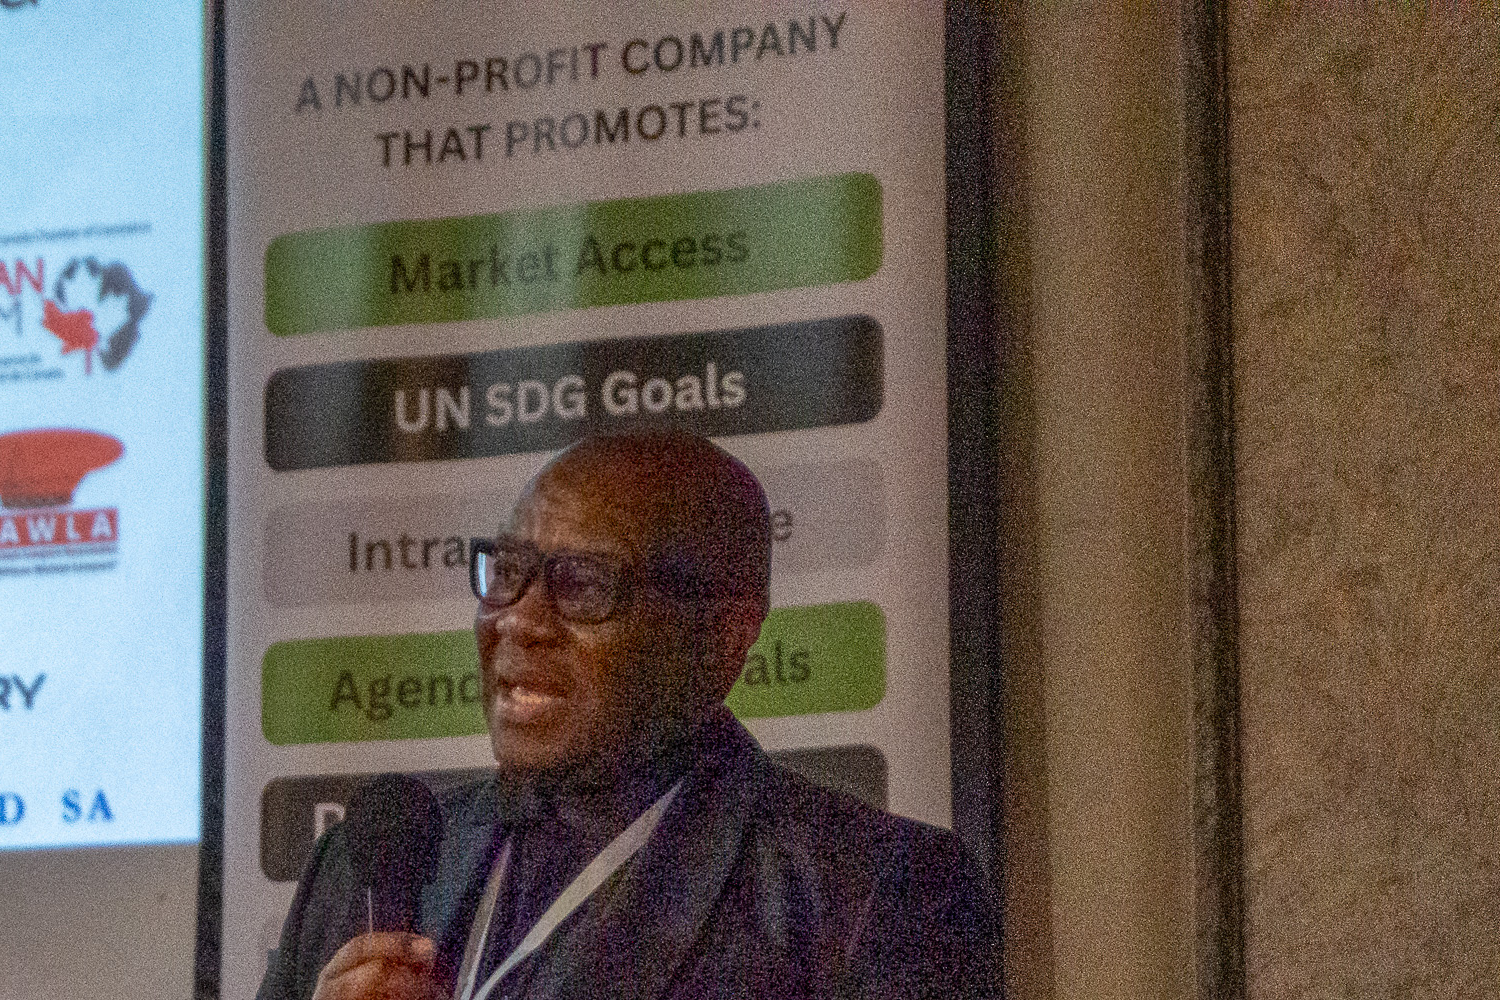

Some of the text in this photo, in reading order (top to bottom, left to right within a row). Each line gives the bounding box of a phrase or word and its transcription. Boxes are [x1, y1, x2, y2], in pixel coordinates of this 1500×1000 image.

[295, 12, 846, 113] A NON-PROFIT COMPANY
[377, 95, 761, 168] THAT PROMOTES:
[389, 225, 750, 295] Market Access
[393, 360, 748, 435] UN SDG Goals
[745, 643, 811, 687] als
[61, 789, 114, 824] SA
